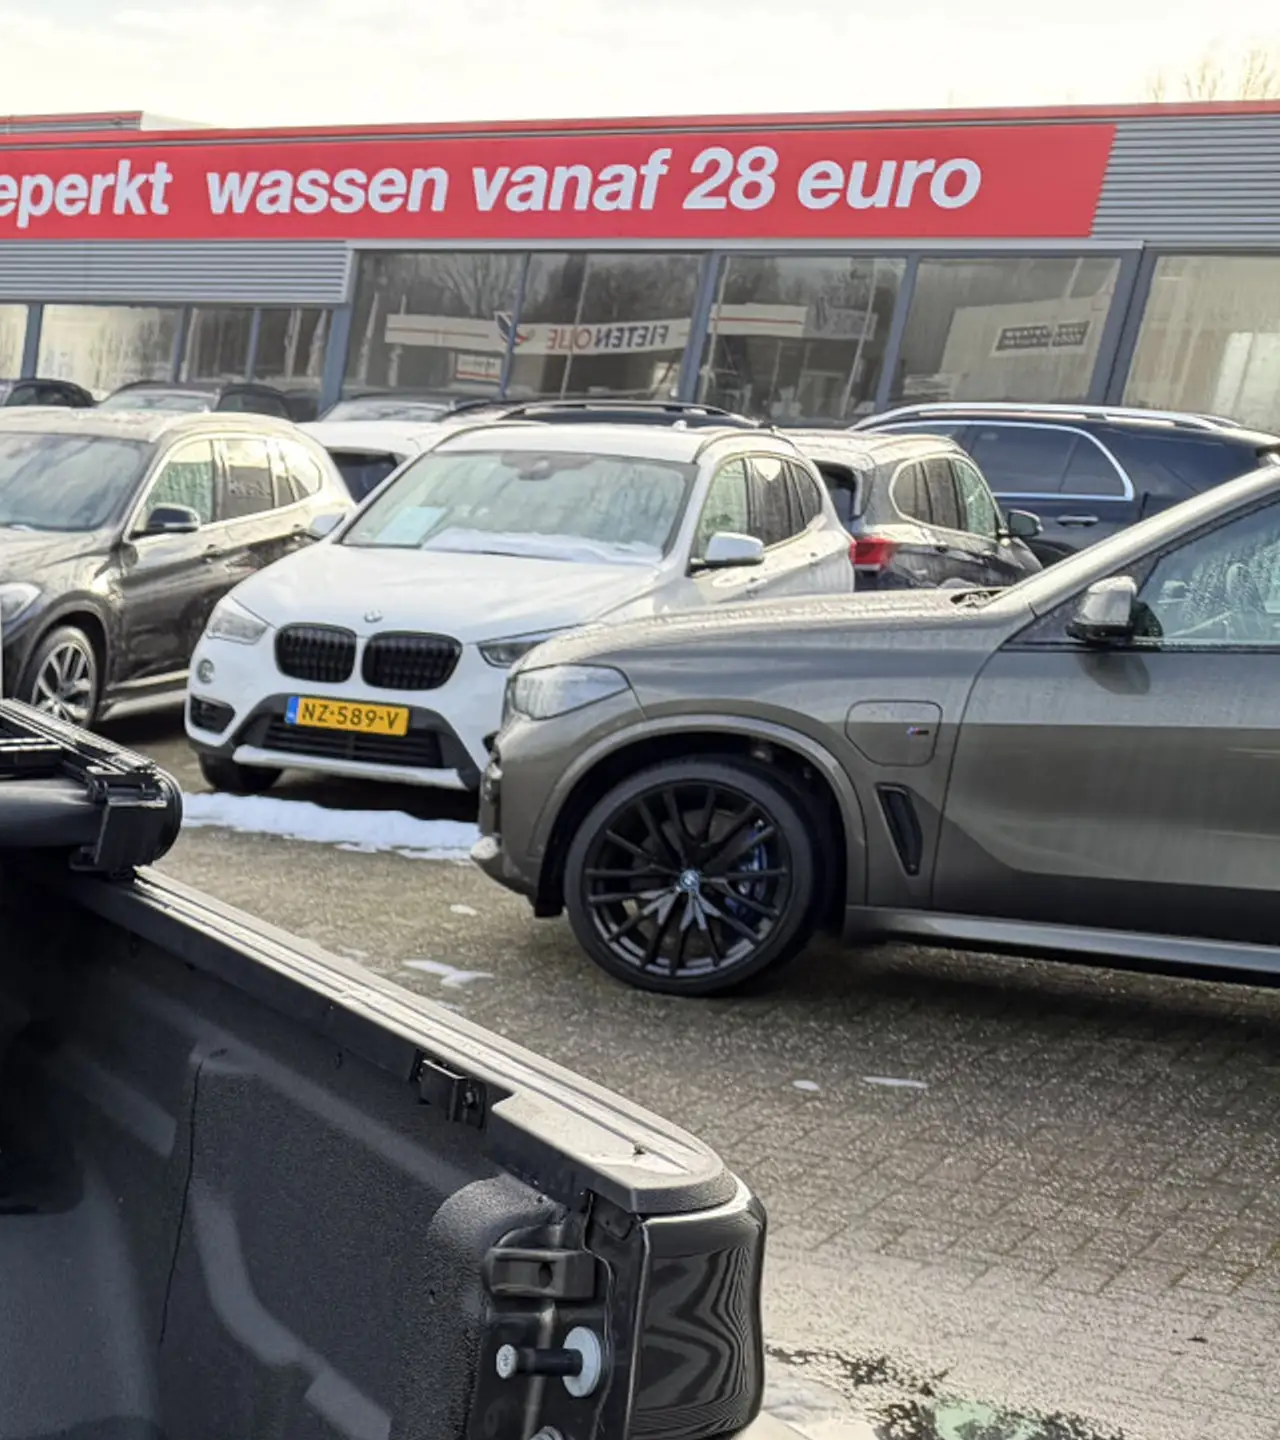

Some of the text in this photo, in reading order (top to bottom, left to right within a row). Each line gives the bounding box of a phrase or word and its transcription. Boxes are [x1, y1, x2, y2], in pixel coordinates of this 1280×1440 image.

[207, 166, 448, 214] wassen
[472, 147, 672, 212] vanaf
[683, 146, 779, 211] 28
[797, 157, 982, 209] euro
[301, 702, 400, 730] NZ-589-V
